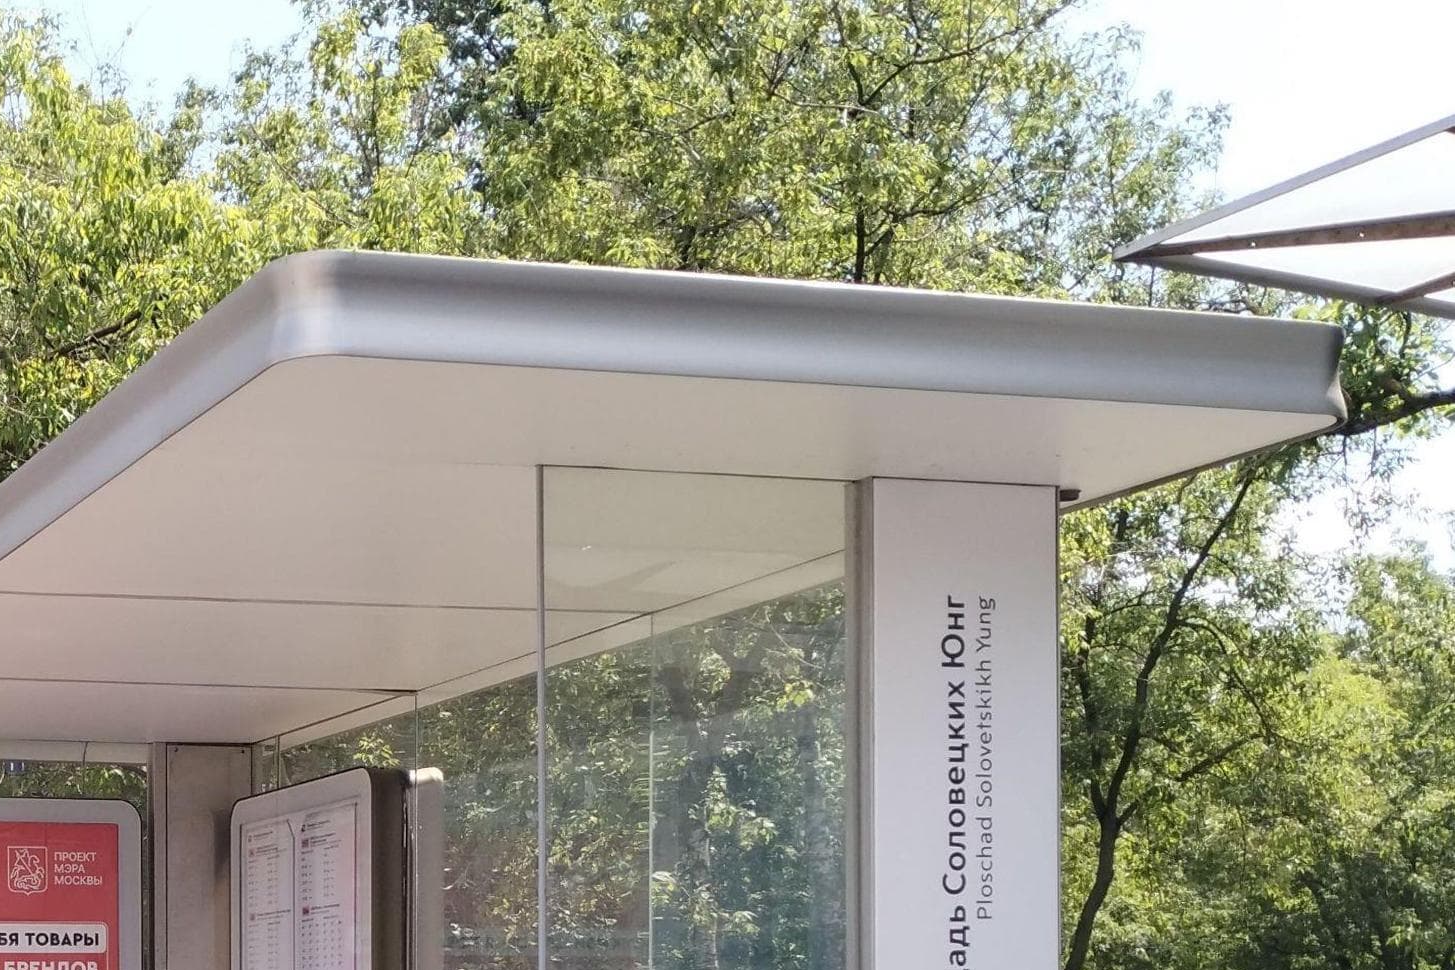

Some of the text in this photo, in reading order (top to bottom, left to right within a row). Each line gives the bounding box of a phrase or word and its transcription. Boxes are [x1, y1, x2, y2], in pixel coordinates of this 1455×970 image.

[941, 596, 966, 668] Юнг
[975, 597, 996, 920] Ploschad Solovetskikh Yung
[942, 681, 970, 894] Соловецких
[54, 852, 96, 863] ПРОЕКТ
[54, 863, 85, 875] МЭРА
[54, 875, 103, 887] МОСКВЫ
[25, 932, 99, 947] ТОВАРЫ
